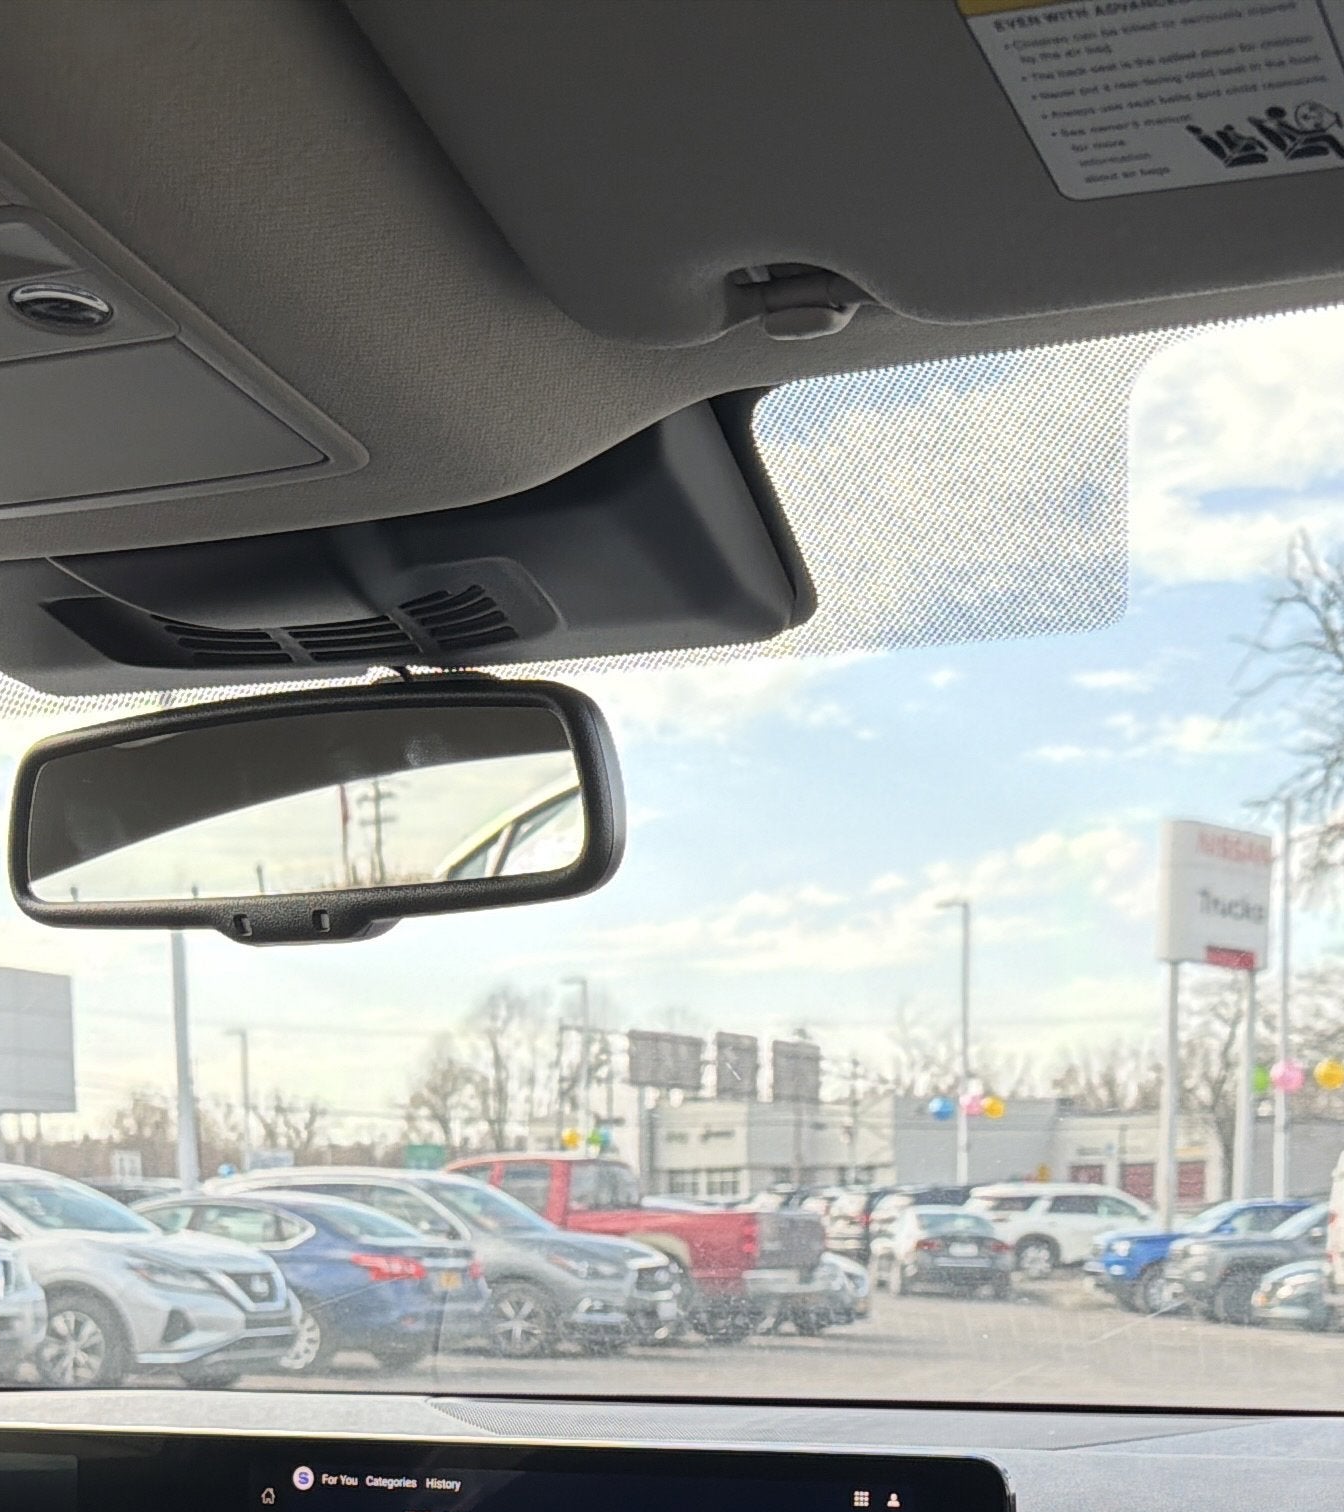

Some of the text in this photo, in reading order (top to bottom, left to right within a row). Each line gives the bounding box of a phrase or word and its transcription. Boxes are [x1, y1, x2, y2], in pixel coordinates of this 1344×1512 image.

[322, 1473, 358, 1487] For You
[366, 1476, 417, 1489] Categories
[426, 1478, 461, 1491] History
